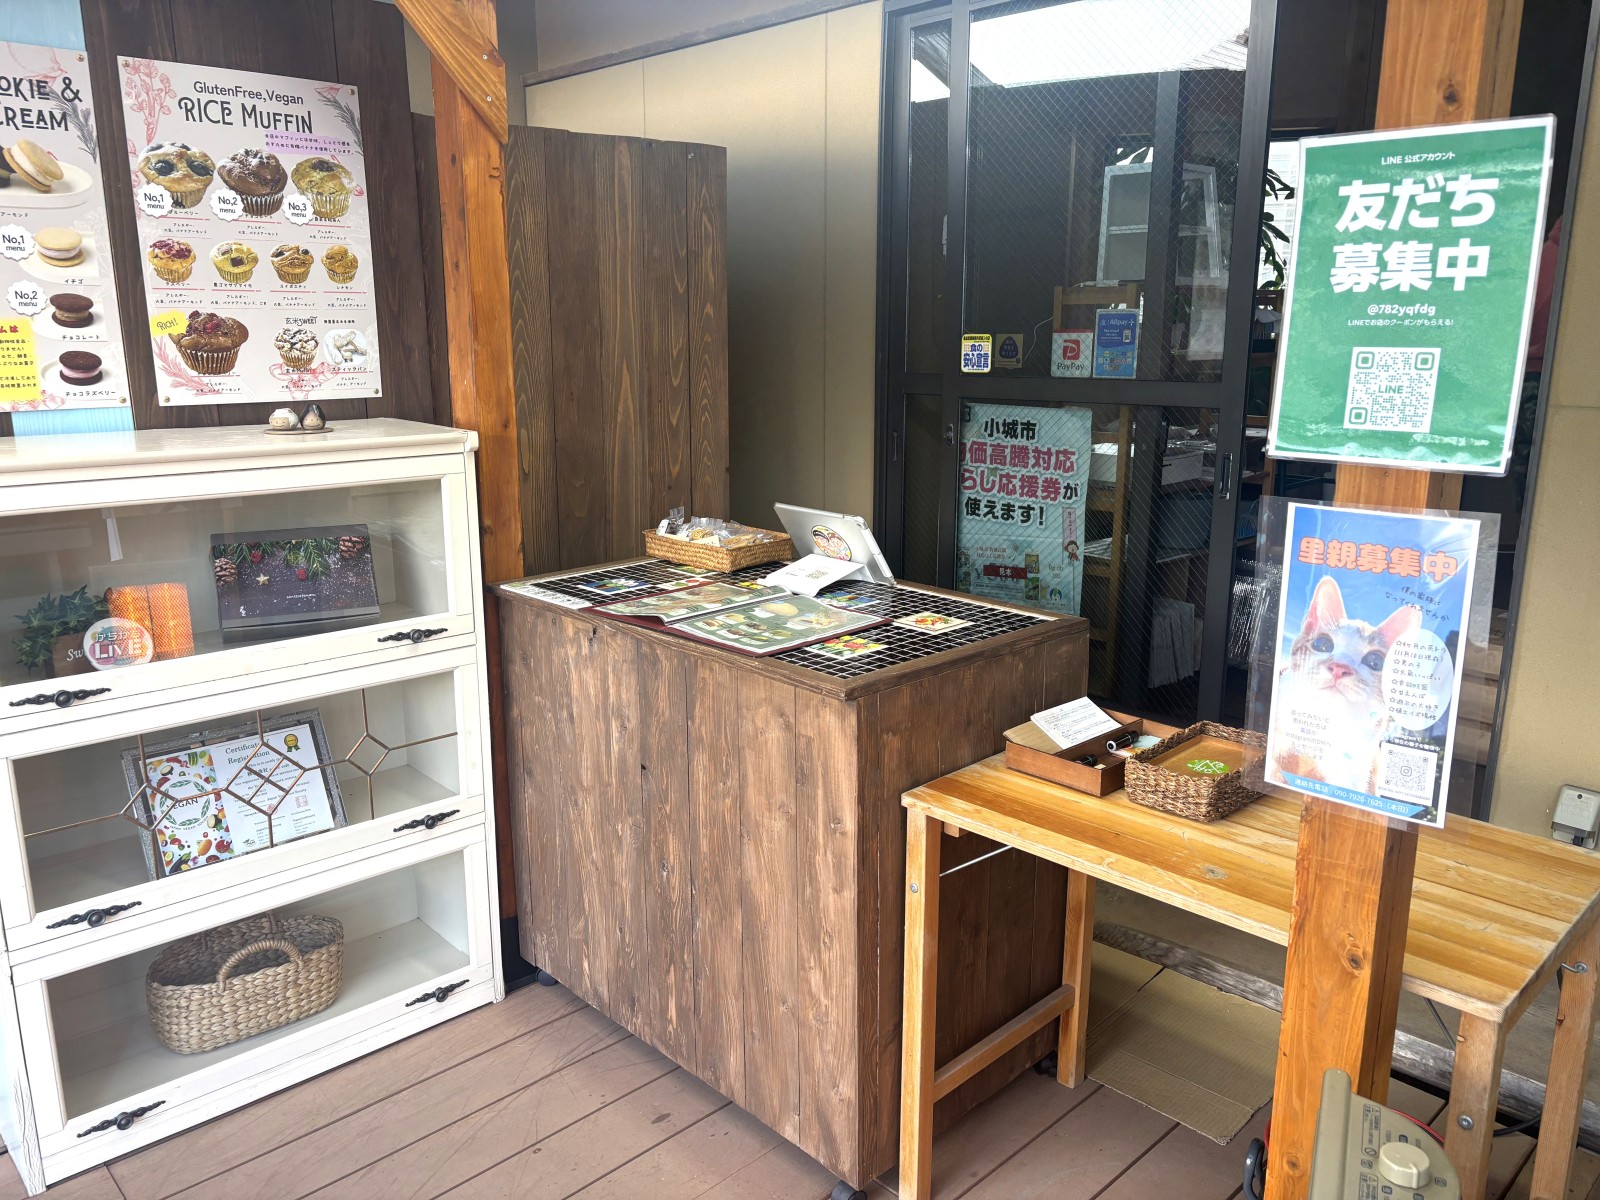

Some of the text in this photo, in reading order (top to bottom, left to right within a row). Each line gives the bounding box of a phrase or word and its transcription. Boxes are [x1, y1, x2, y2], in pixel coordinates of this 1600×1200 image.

[61, 76, 83, 102] &
[0, 105, 69, 131] REAM
[177, 96, 234, 126] RICE
[1381, 151, 1456, 165] LINE 公式アカウント
[1335, 173, 1500, 232] 友だち
[1330, 238, 1491, 293] 募集中
[1367, 303, 1437, 316] @782yqfdg
[1057, 362, 1085, 371] PayPay
[1378, 385, 1405, 394] LINE
[984, 417, 1037, 442] 小城市
[1298, 536, 1458, 582] 里親募集中
[66, 648, 84, 661] Sw
[225, 742, 263, 755] Certificat
